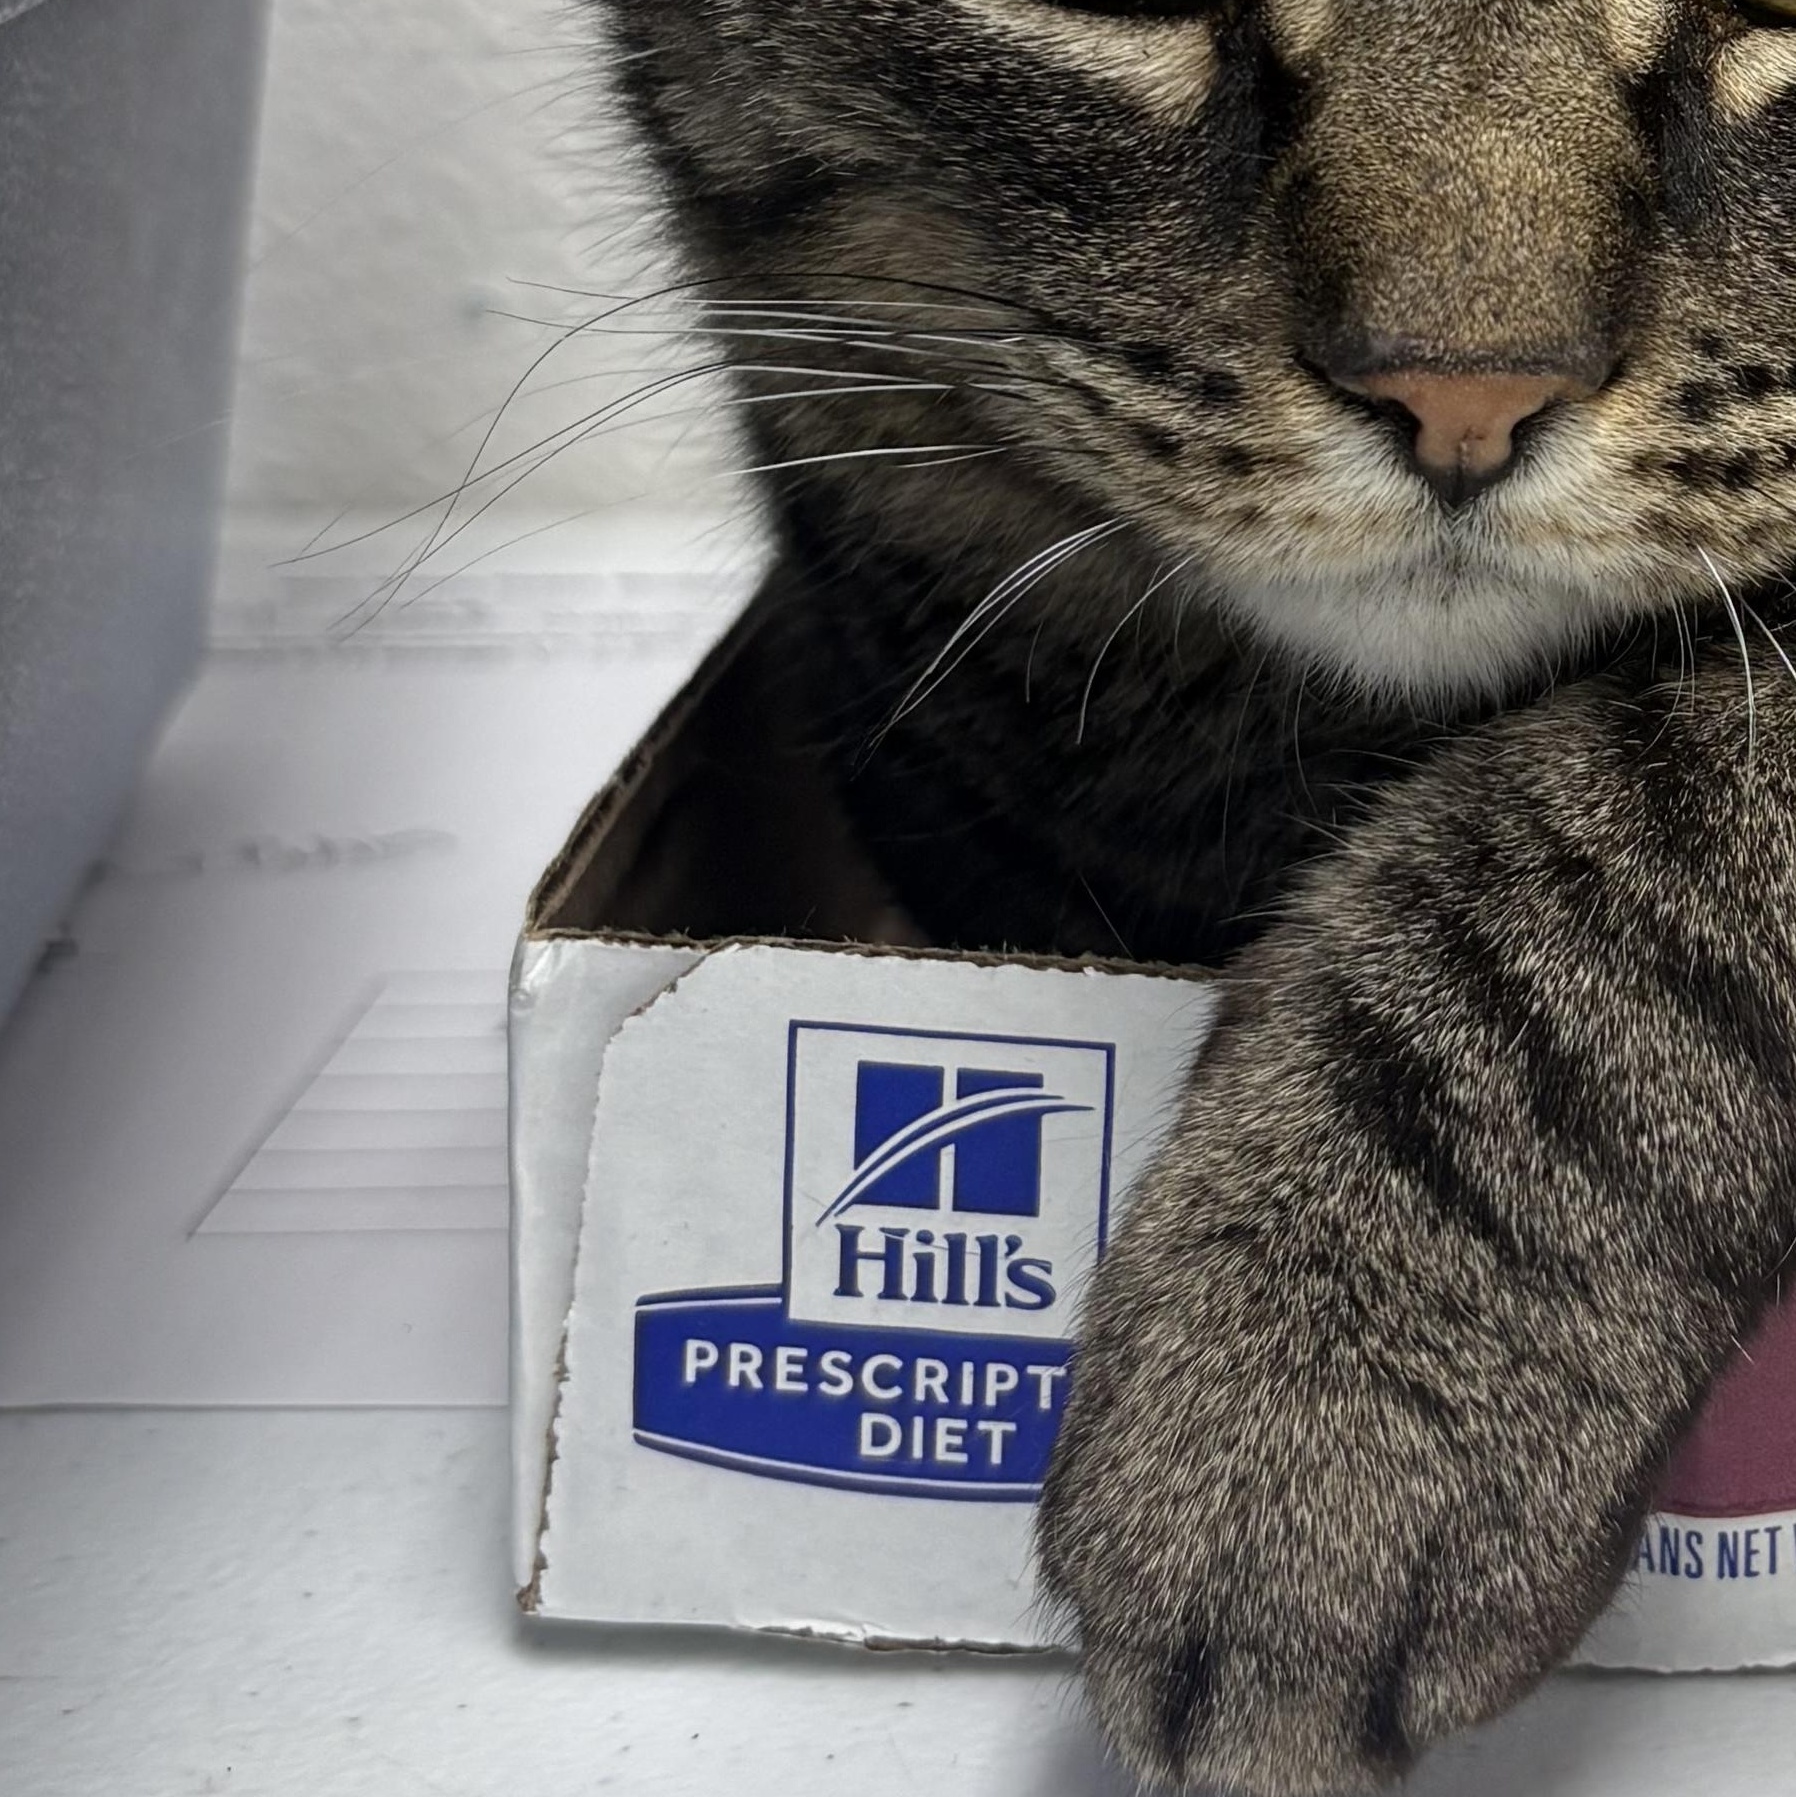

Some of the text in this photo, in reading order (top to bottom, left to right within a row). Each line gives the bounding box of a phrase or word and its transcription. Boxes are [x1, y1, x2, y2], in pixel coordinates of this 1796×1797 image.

[832, 1222, 1057, 1311] Hill's
[683, 1338, 1067, 1410] PRESCRIPT
[858, 1411, 1018, 1466] DIET
[1716, 1525, 1783, 1580] NET
